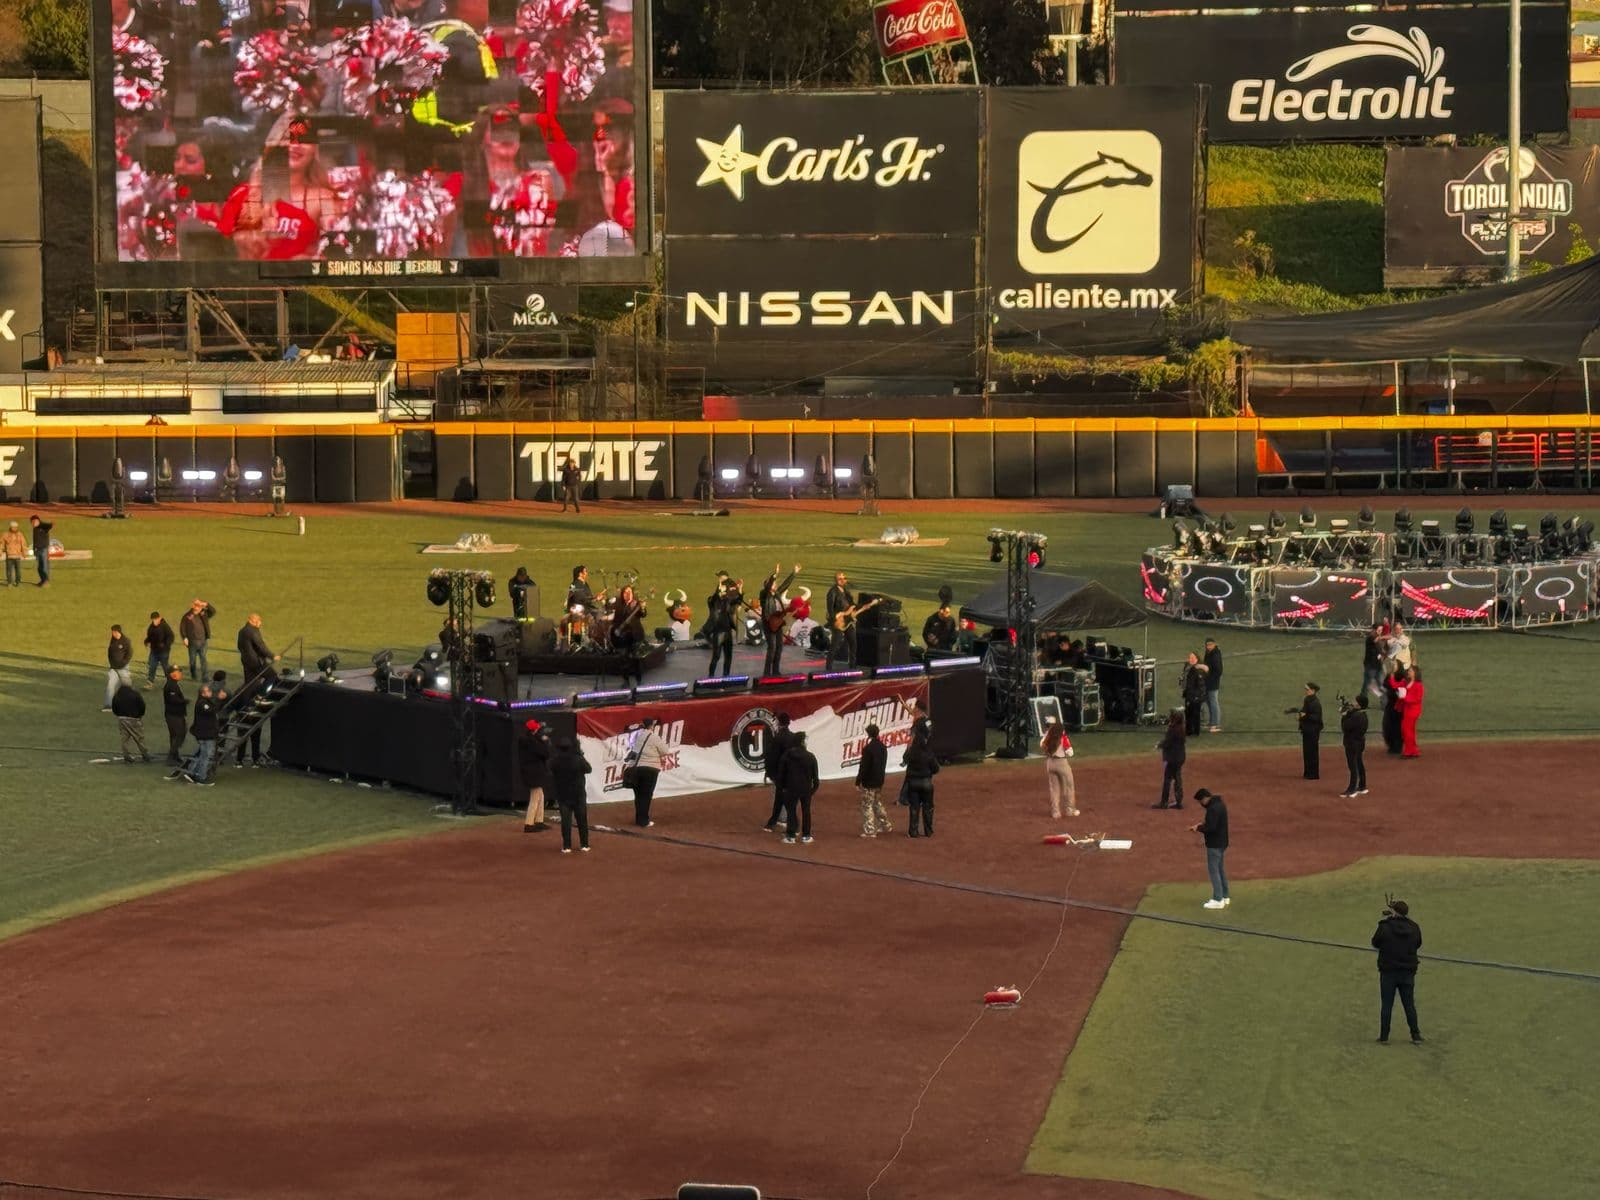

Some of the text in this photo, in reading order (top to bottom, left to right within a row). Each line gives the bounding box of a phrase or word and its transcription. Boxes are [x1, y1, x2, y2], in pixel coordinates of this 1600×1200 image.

[883, 0, 956, 47] Coca-Cola
[1227, 75, 1455, 122] Electrolit
[756, 134, 873, 186] Carl's
[1450, 183, 1567, 212] TOROLNDIA
[686, 290, 954, 326] NISSAN
[999, 282, 1178, 309] caliente.mx
[512, 311, 559, 326] MEGA
[519, 441, 661, 483] TECATE
